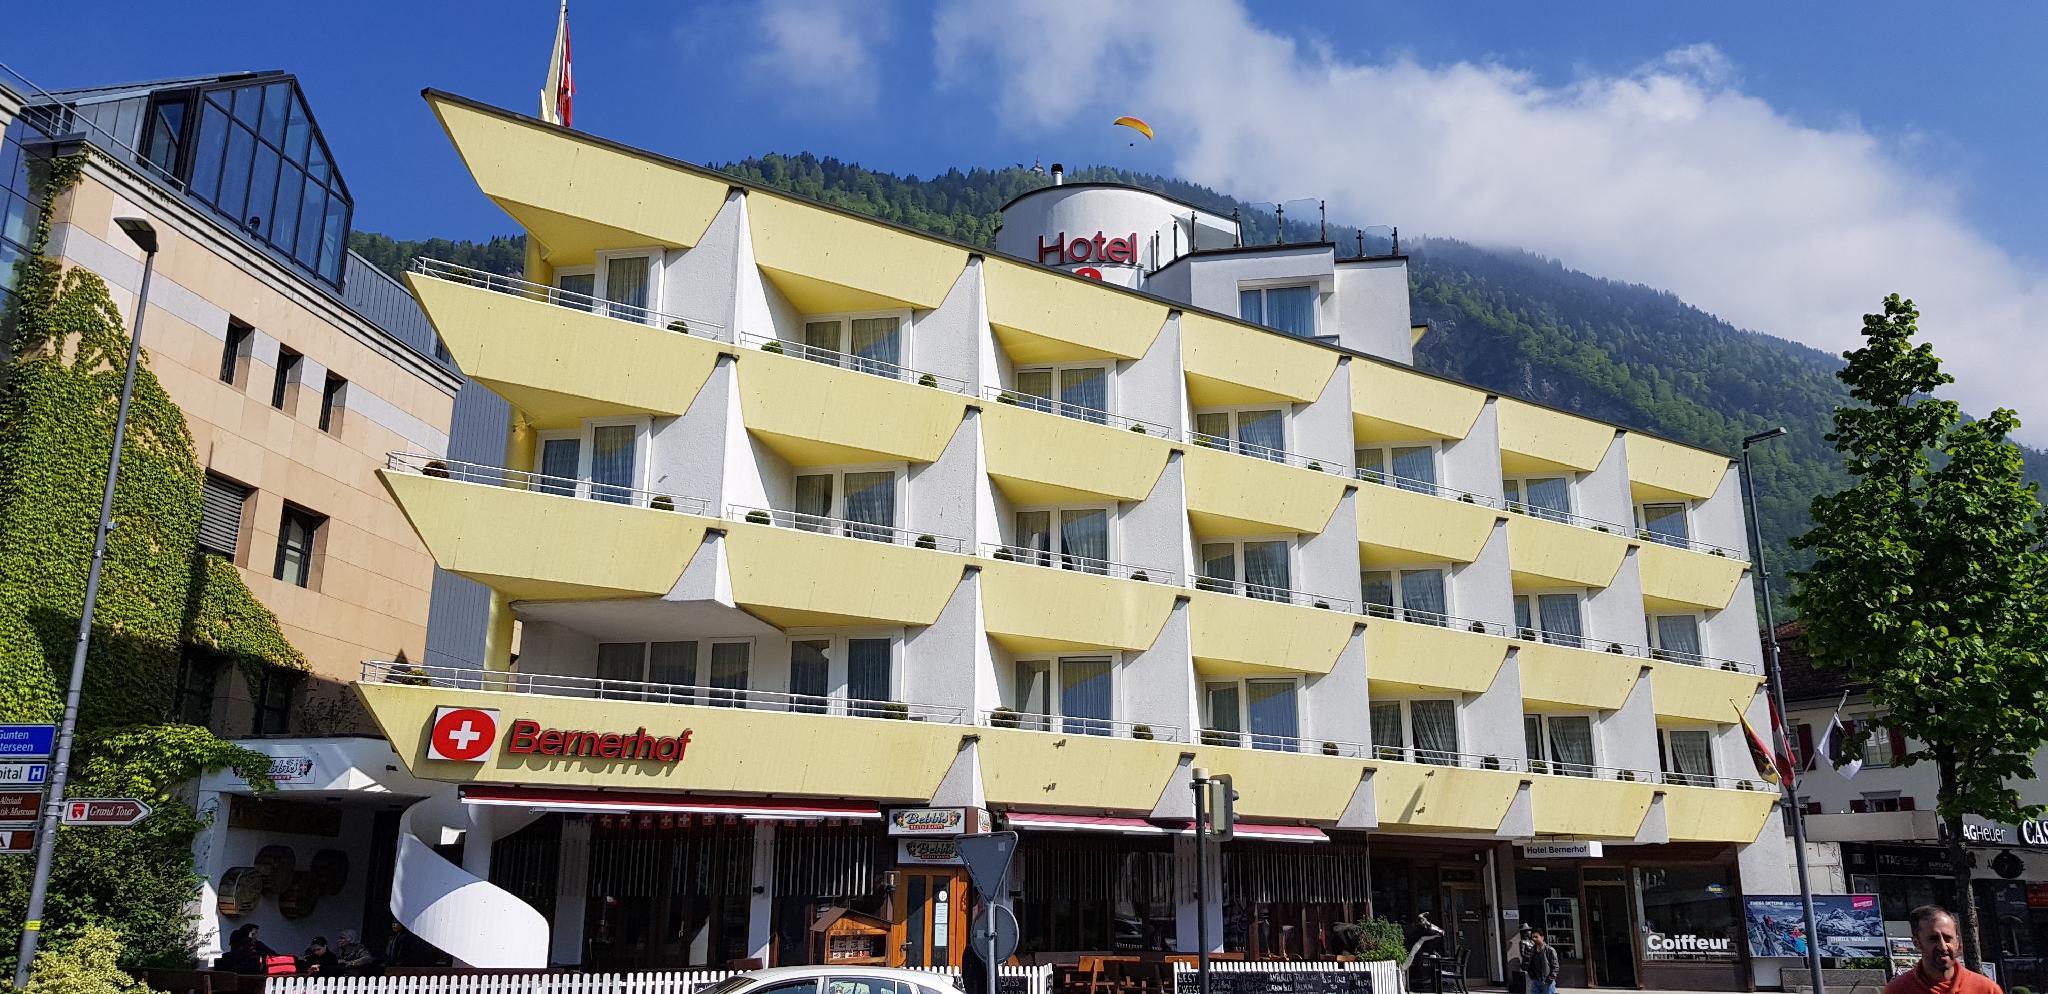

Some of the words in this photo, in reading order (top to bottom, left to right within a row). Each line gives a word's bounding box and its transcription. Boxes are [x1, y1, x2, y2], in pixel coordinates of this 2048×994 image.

[1038, 231, 1137, 264] Hotel
[508, 718, 693, 762] Bernerhof
[89, 805, 114, 816] Grand
[116, 806, 134, 816] Tour
[1963, 824, 2007, 842] AGHeuer
[1526, 846, 1547, 854] Hotel
[1548, 845, 1587, 853] Bernerhof
[1647, 934, 1730, 950] Coiffeur
